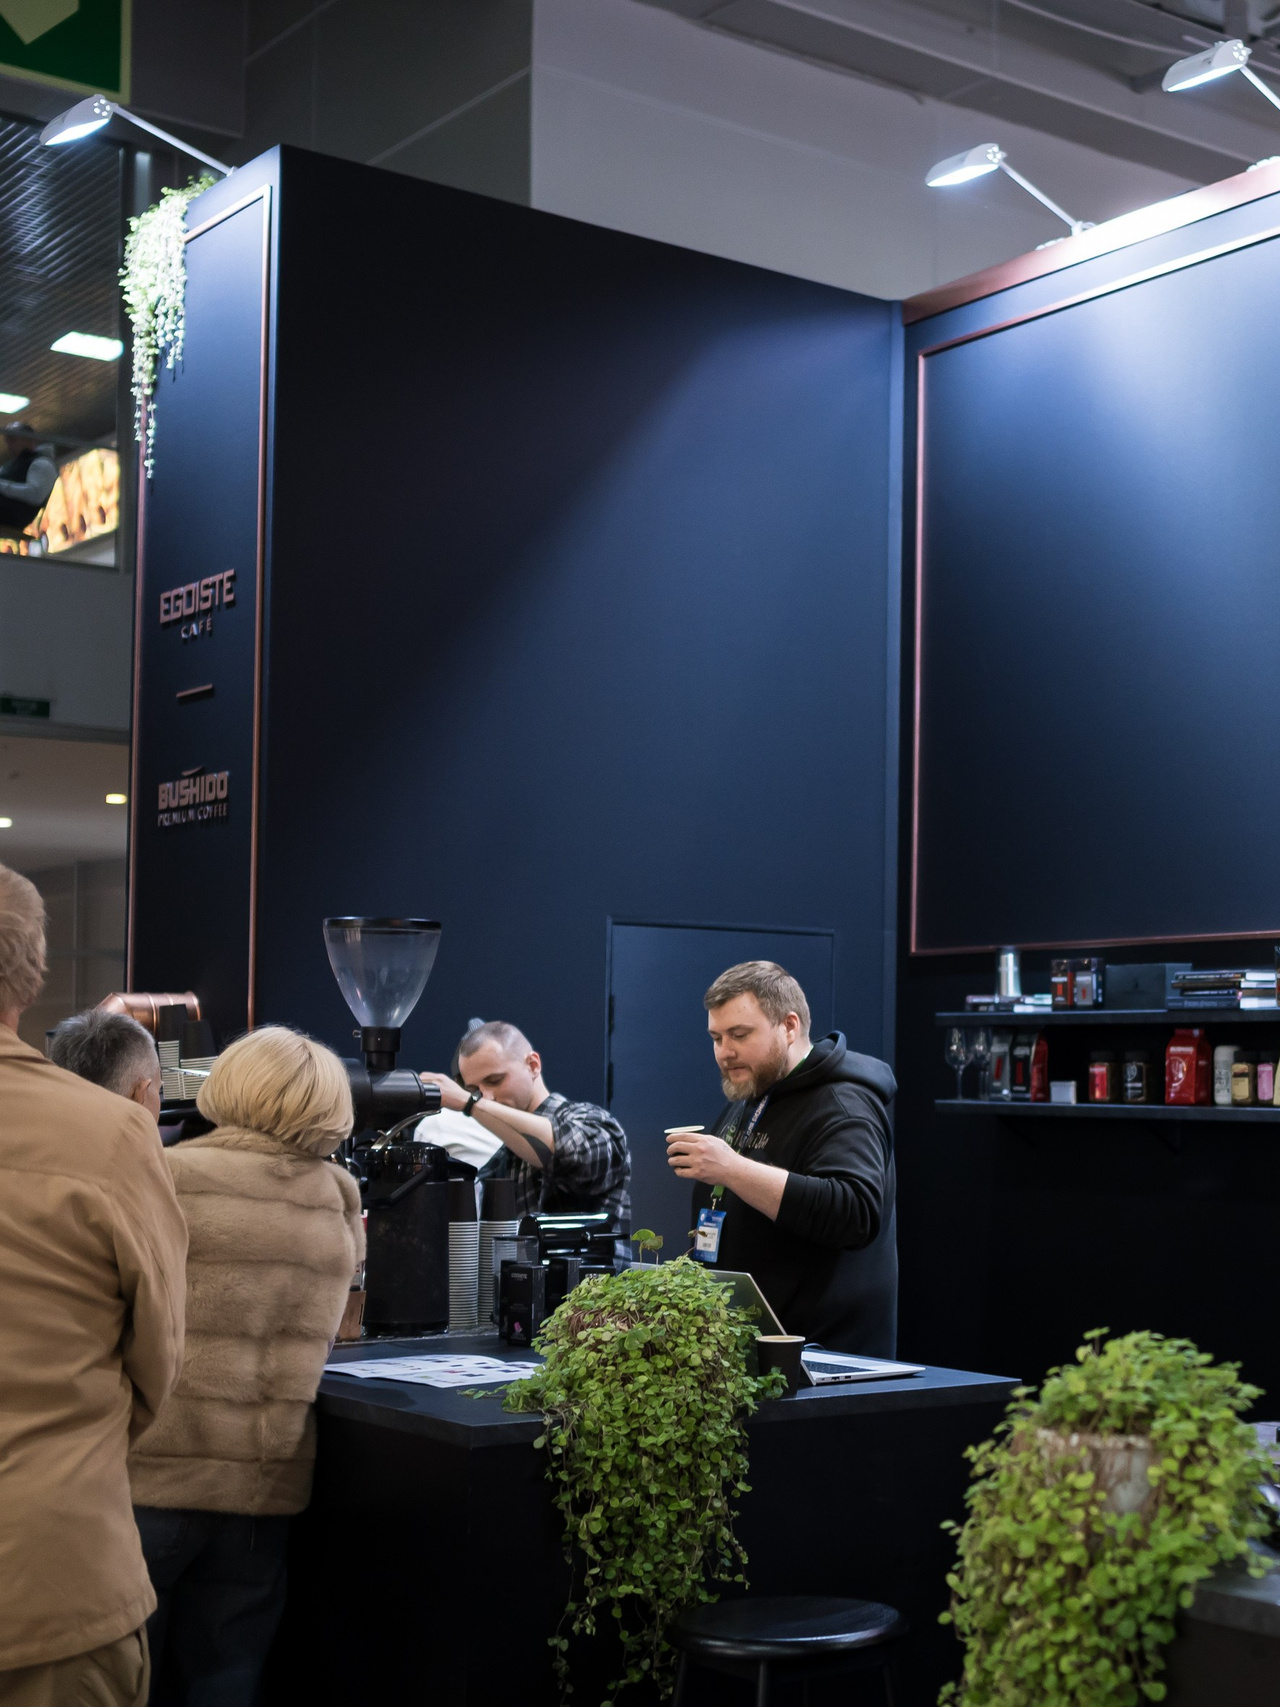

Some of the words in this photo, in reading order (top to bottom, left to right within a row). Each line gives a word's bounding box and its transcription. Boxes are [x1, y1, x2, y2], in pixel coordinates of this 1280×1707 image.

[159, 568, 235, 624] EGOISTE
[158, 770, 229, 811] BUSHIDO
[158, 808, 195, 827] PREMIUM
[197, 803, 228, 820] COFFEE
